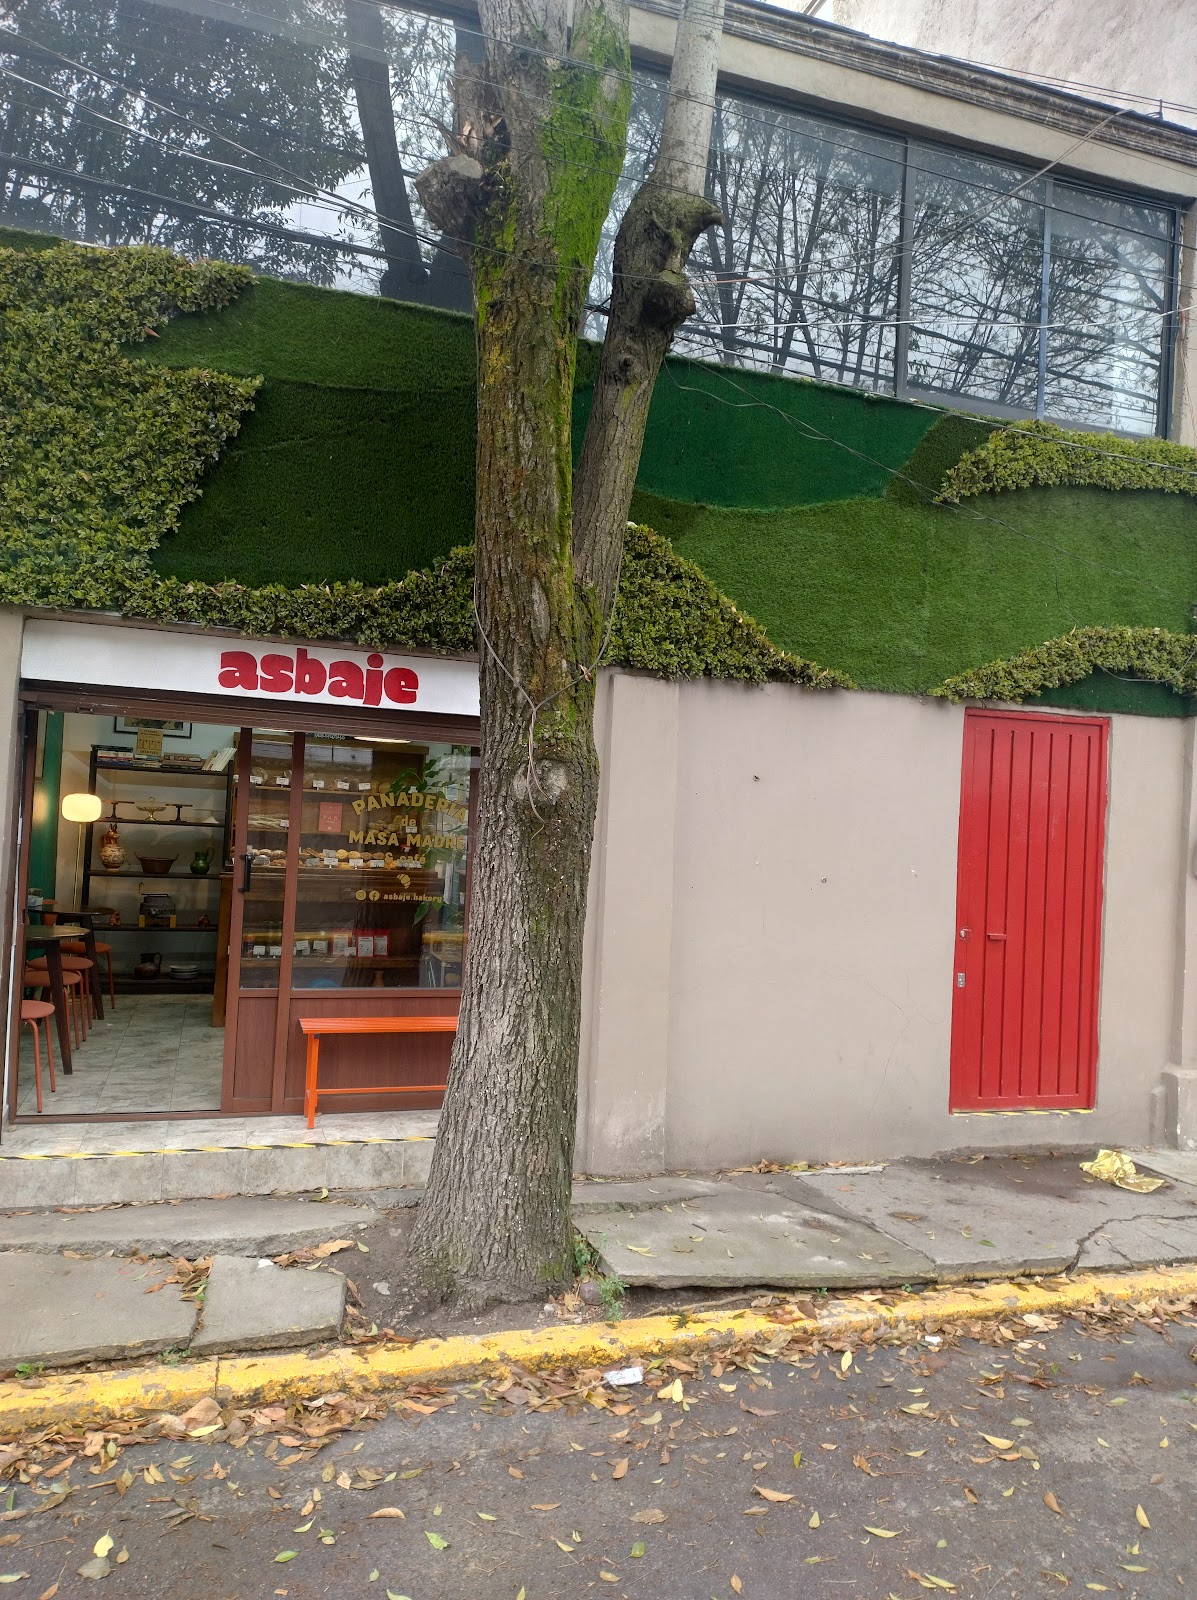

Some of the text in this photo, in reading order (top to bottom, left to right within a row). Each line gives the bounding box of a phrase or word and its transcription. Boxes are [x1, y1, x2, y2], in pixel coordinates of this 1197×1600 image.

[218, 648, 419, 706] asbaje
[401, 815, 417, 827] de
[348, 830, 400, 846] MASA
[406, 833, 465, 849] MADRE
[400, 854, 426, 865] café
[383, 892, 443, 903] asbaje.bakery
